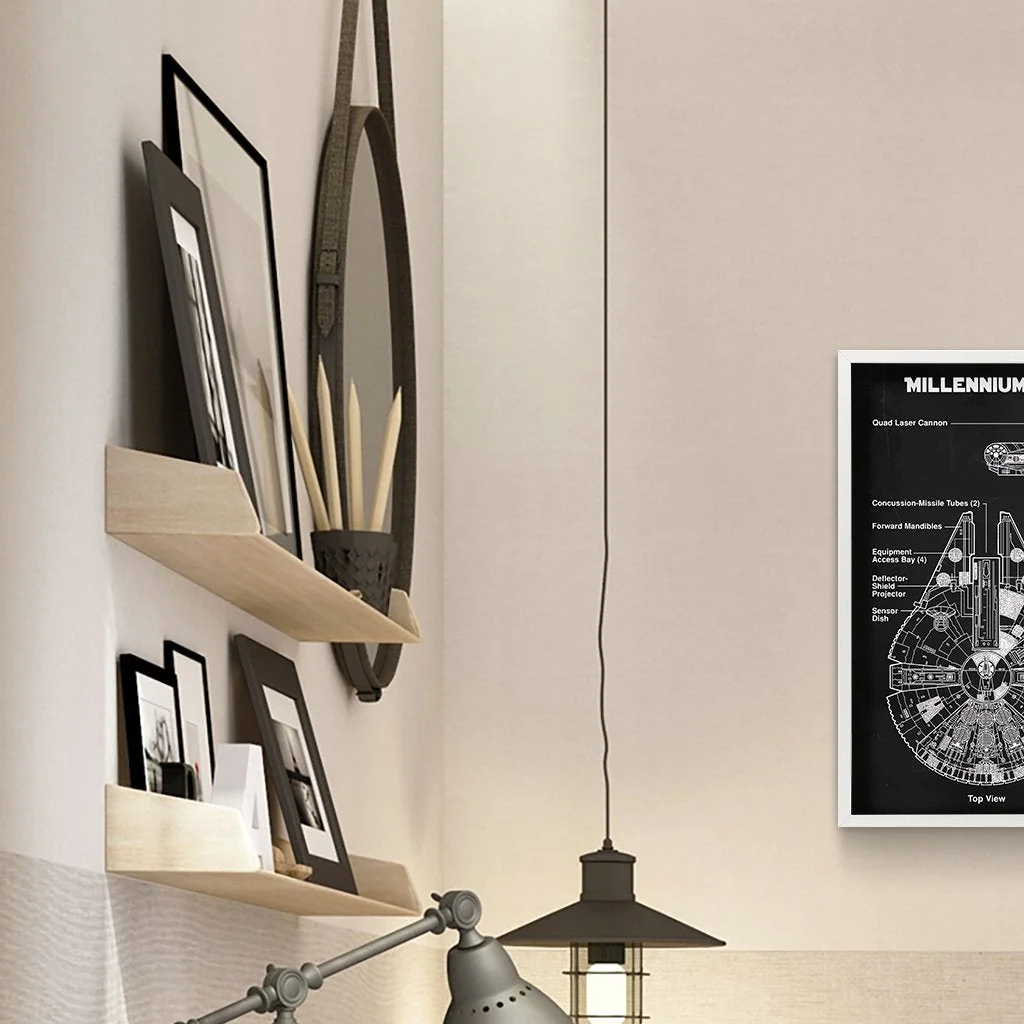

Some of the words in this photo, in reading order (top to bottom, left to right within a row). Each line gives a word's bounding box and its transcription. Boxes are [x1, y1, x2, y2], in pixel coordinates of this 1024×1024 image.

[872, 419, 893, 427] Quad
[872, 499, 944, 507] Concussion-Missile
[946, 499, 969, 507] Tubes
[970, 499, 980, 508] (2)
[872, 522, 902, 530] Forward
[905, 522, 942, 530] Mandibles
[872, 548, 912, 557] Equipment
[872, 556, 898, 564] Access
[901, 556, 915, 565] Bay
[917, 556, 927, 565] (4)
[872, 582, 895, 590] Shield
[872, 590, 906, 599] Projector
[968, 794, 984, 804] Top
[986, 794, 1006, 803] View
